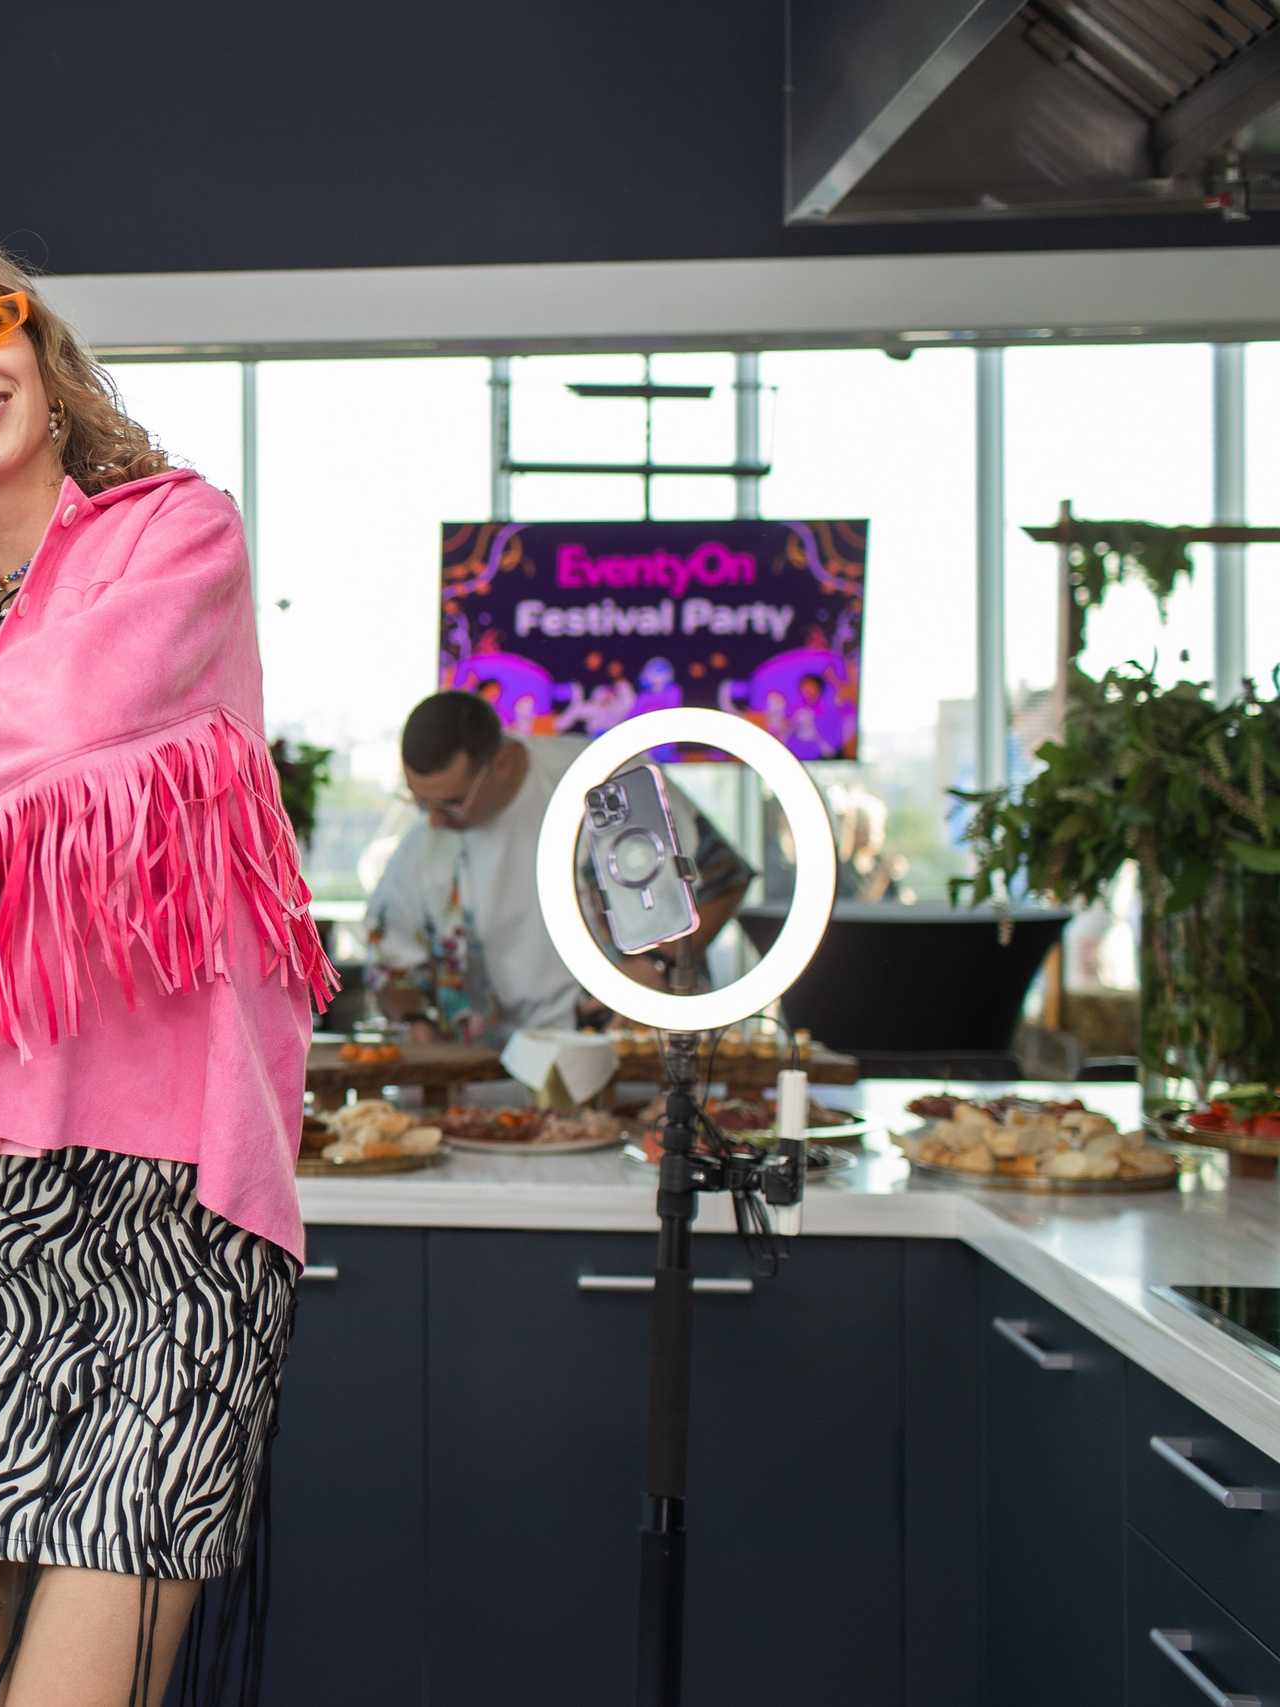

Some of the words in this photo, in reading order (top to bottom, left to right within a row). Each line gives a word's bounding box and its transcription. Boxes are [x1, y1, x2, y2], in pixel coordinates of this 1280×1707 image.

[557, 542, 755, 596] EventyOn
[516, 599, 672, 636] Festival
[682, 599, 793, 640] Party
